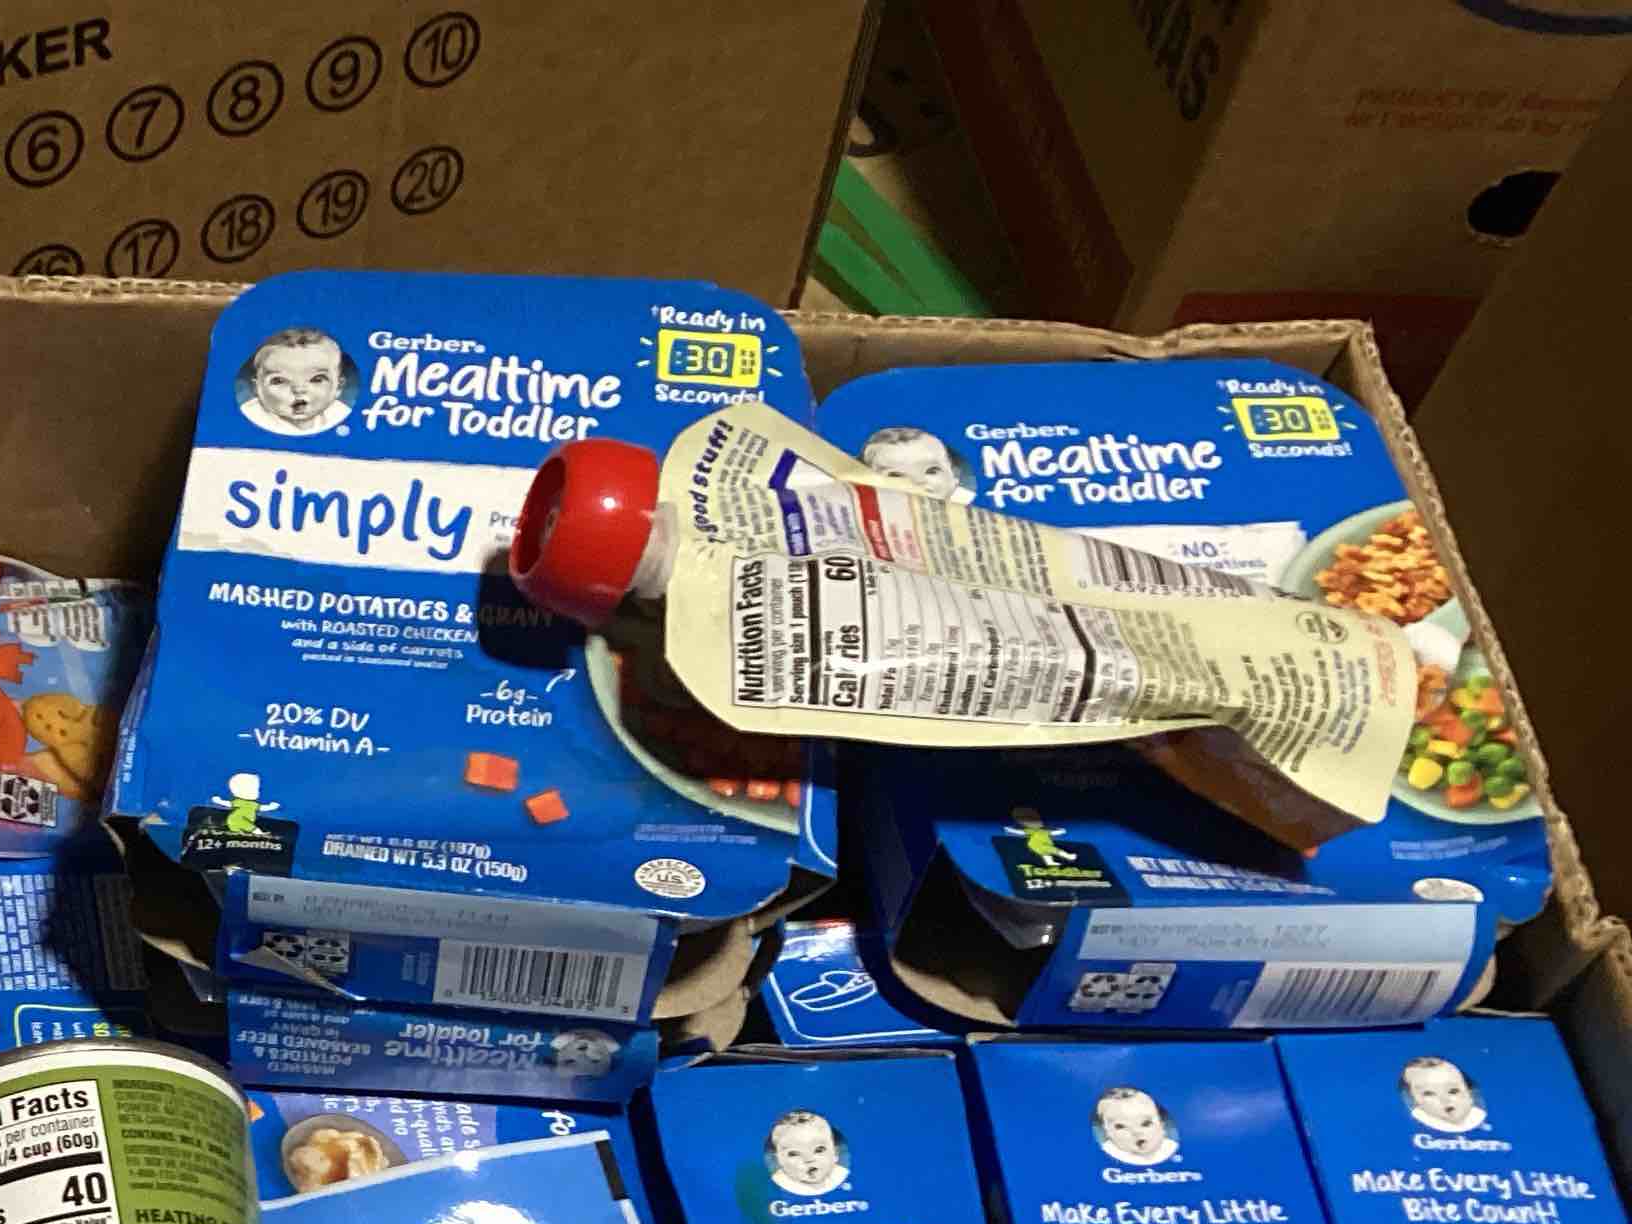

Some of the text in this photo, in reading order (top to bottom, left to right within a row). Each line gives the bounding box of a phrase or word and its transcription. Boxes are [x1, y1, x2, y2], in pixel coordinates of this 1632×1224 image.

[741, 311, 766, 332] in
[371, 353, 622, 409] Mealtime
[362, 396, 600, 441] for Toddler
[982, 434, 1222, 478] Mealtime
[986, 473, 1211, 508] for Toddler
[224, 469, 473, 561] simply
[825, 556, 856, 582] 60
[208, 581, 449, 623] MASHED POTATOES
[322, 620, 479, 644] ROASTED CHICKEN
[736, 559, 764, 703] Nutrition Facts
[266, 702, 370, 733] 20% DV
[466, 703, 553, 729] Protein
[226, 838, 283, 853] months
[399, 1022, 492, 1048] Toddler
[11, 1088, 88, 1120] Facts
[31, 1115, 95, 1136] container
[23, 1132, 98, 1159] cup (60g)
[61, 1172, 107, 1206] 40
[1351, 1167, 1596, 1200] Make Every Little
[1041, 1201, 1112, 1224] Make
[1202, 1199, 1288, 1224] Little
[1402, 1197, 1461, 1223] Bite
